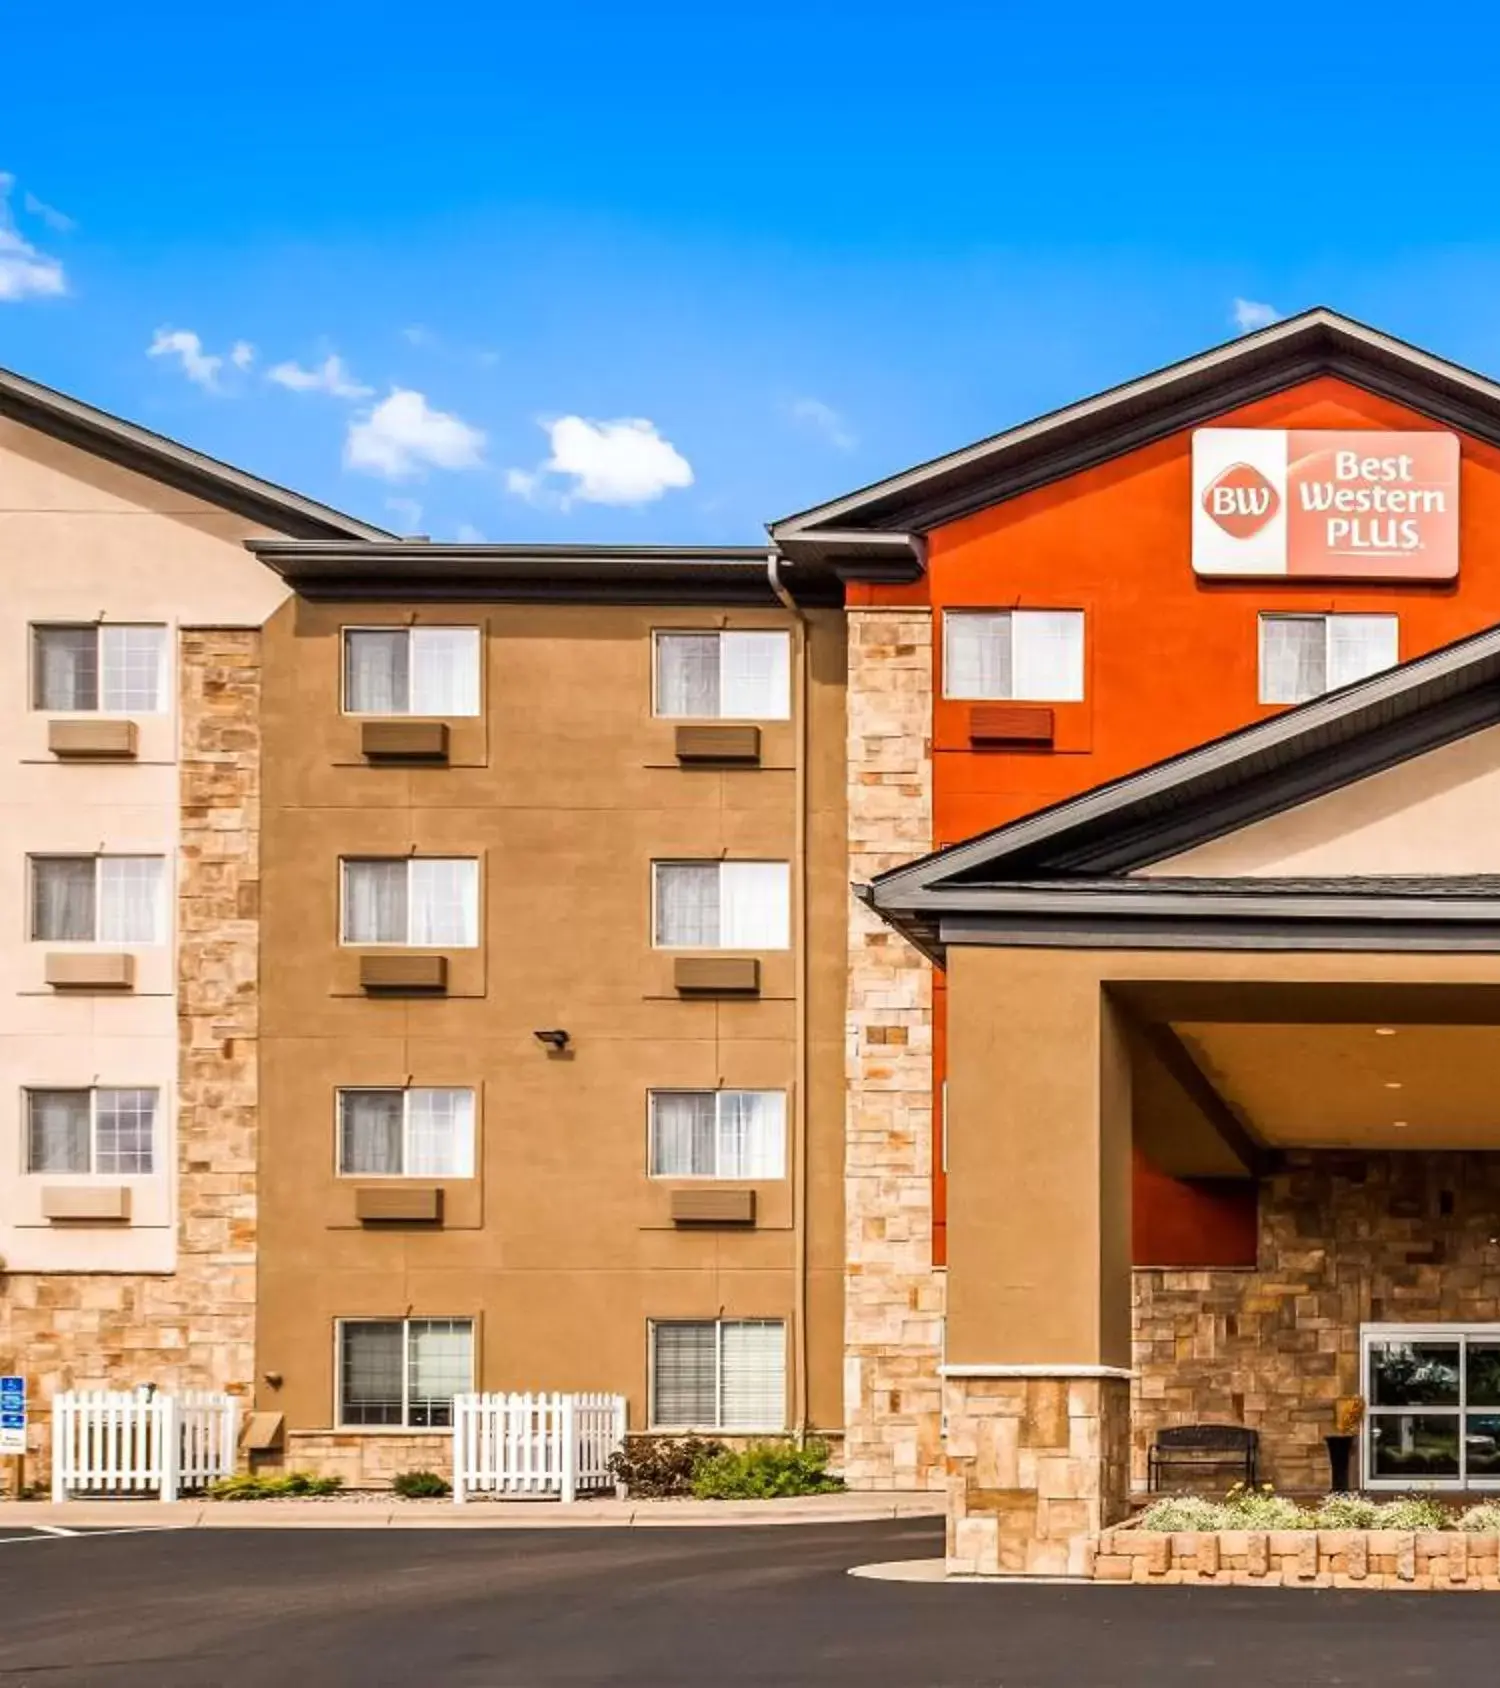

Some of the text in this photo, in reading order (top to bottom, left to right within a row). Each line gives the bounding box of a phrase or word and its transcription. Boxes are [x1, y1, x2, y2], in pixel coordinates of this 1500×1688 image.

[1335, 451, 1413, 482] Best
[1213, 487, 1270, 515] BW
[1300, 481, 1446, 513] Western
[1327, 518, 1419, 549] PLUS
